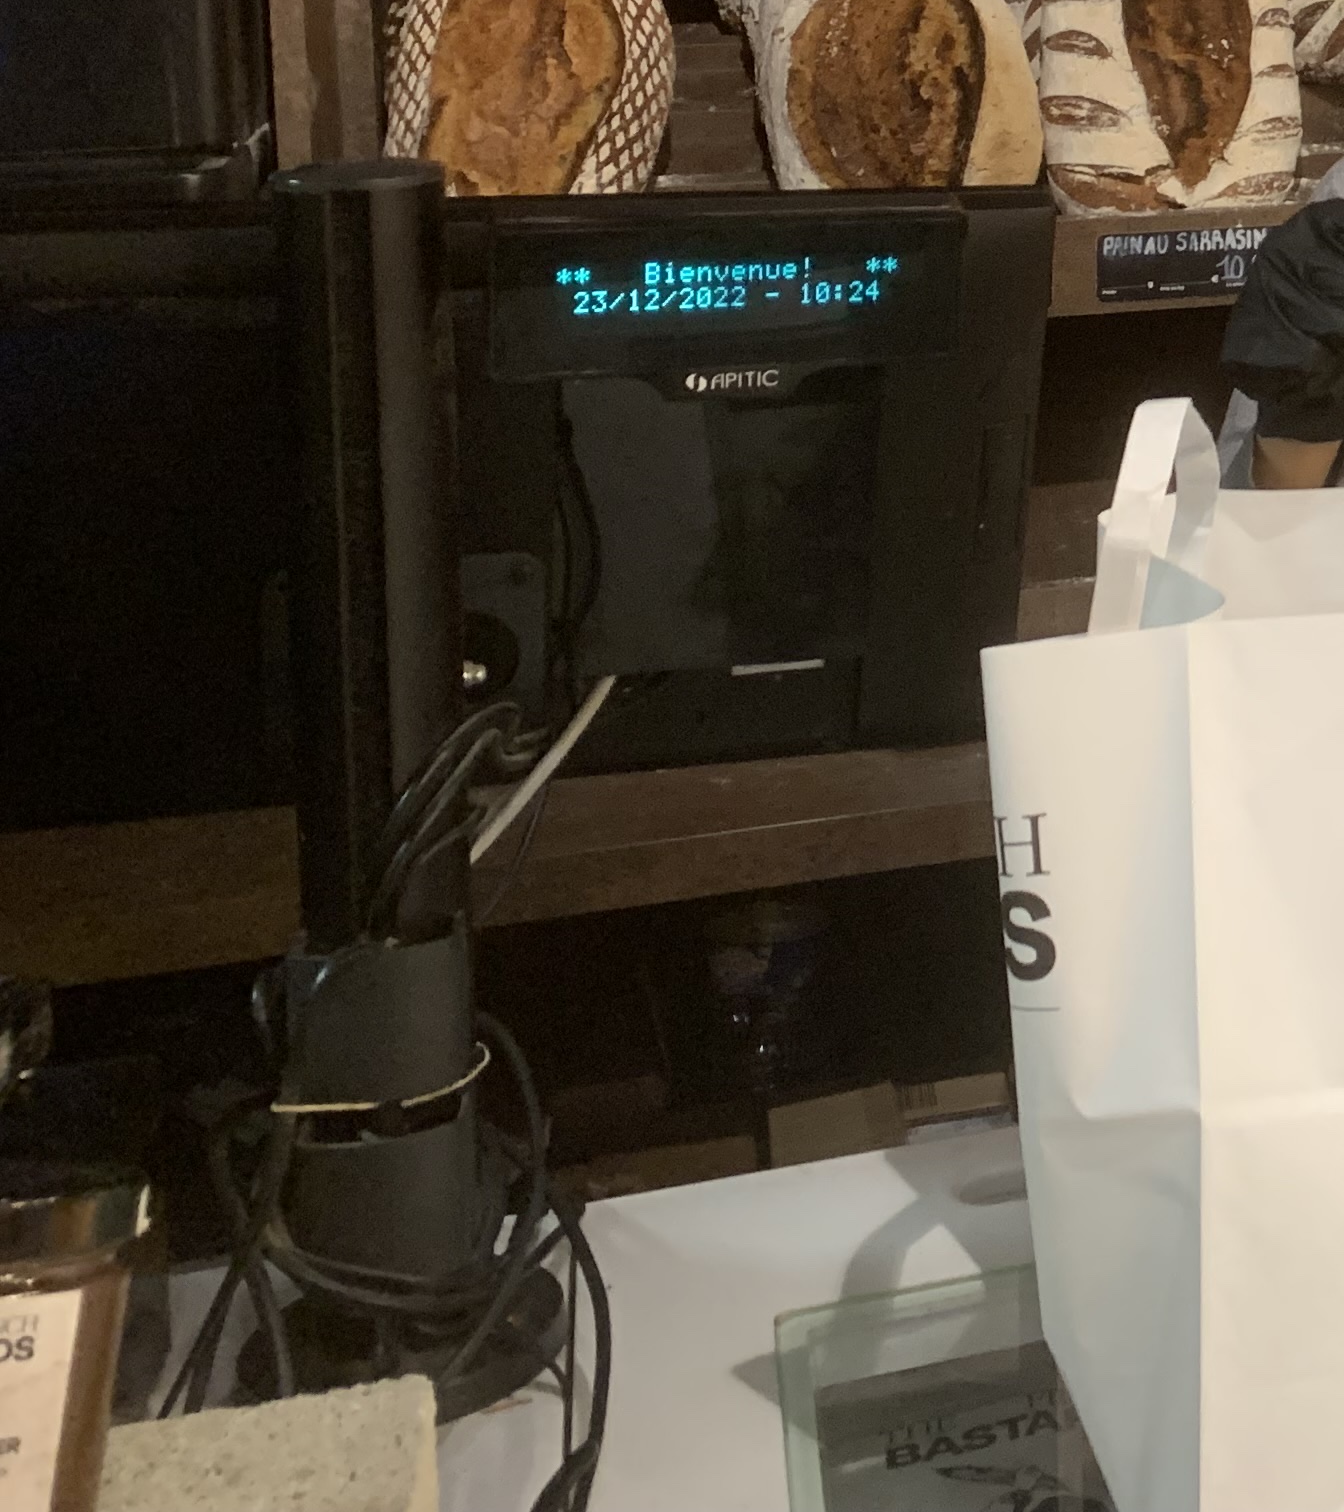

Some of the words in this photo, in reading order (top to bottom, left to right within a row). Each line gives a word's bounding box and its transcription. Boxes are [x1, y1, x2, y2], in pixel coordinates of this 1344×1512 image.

[644, 257, 812, 284] Bienvenue!
[573, 285, 747, 315] 23/12/2022
[800, 279, 880, 304] 10:24
[710, 370, 779, 390] APITIC
